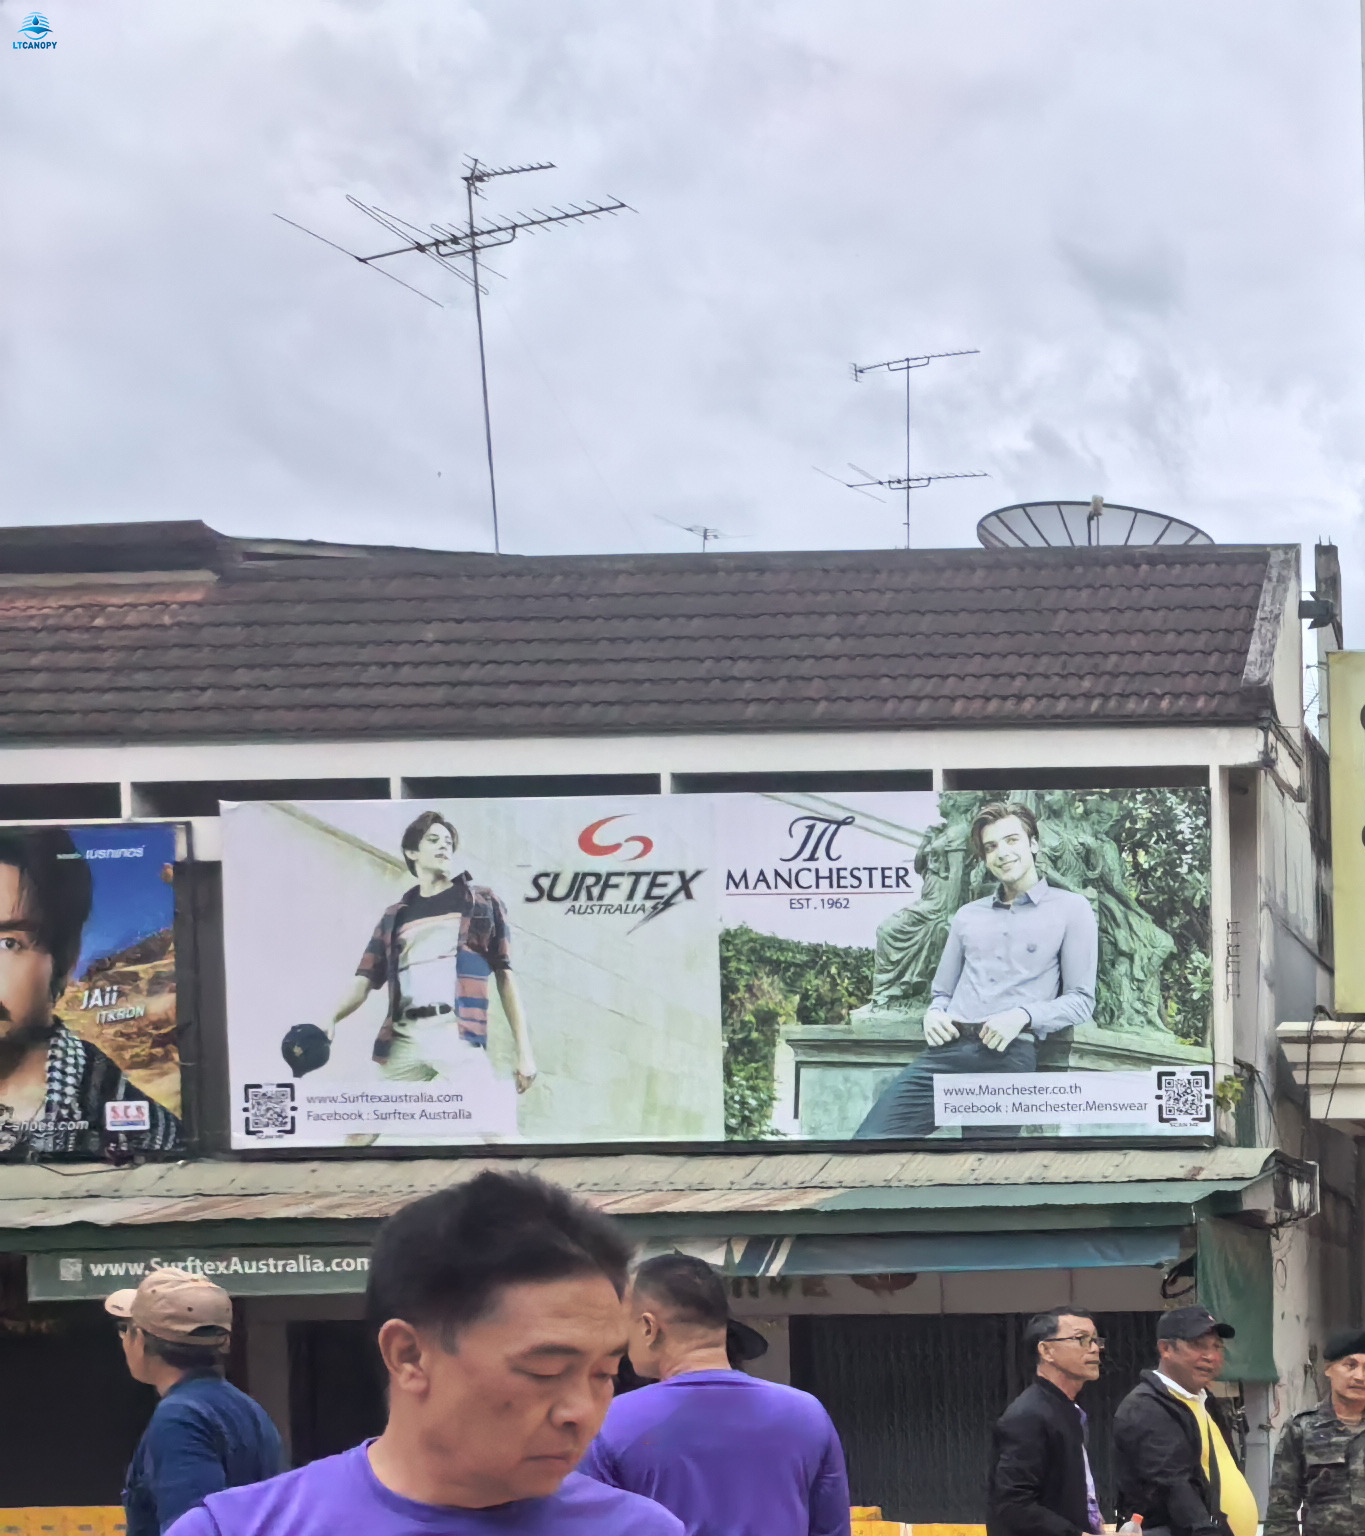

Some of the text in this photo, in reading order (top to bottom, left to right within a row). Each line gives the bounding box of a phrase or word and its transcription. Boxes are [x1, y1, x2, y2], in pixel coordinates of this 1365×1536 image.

[524, 867, 708, 903] SURFTEX
[725, 867, 912, 891] MANCHESTER
[565, 903, 647, 916] AUSTRALIA
[821, 897, 850, 910] 1962
[943, 1084, 1082, 1096] www.Manchester.co.th
[306, 1092, 463, 1105] www.Surftexaustralia.com
[944, 1102, 1002, 1114] Facebook
[1011, 1100, 1149, 1113] Manchester.Menswear
[307, 1110, 363, 1121] Facebook
[373, 1109, 416, 1121] Surftex
[419, 1108, 472, 1120] Australia
